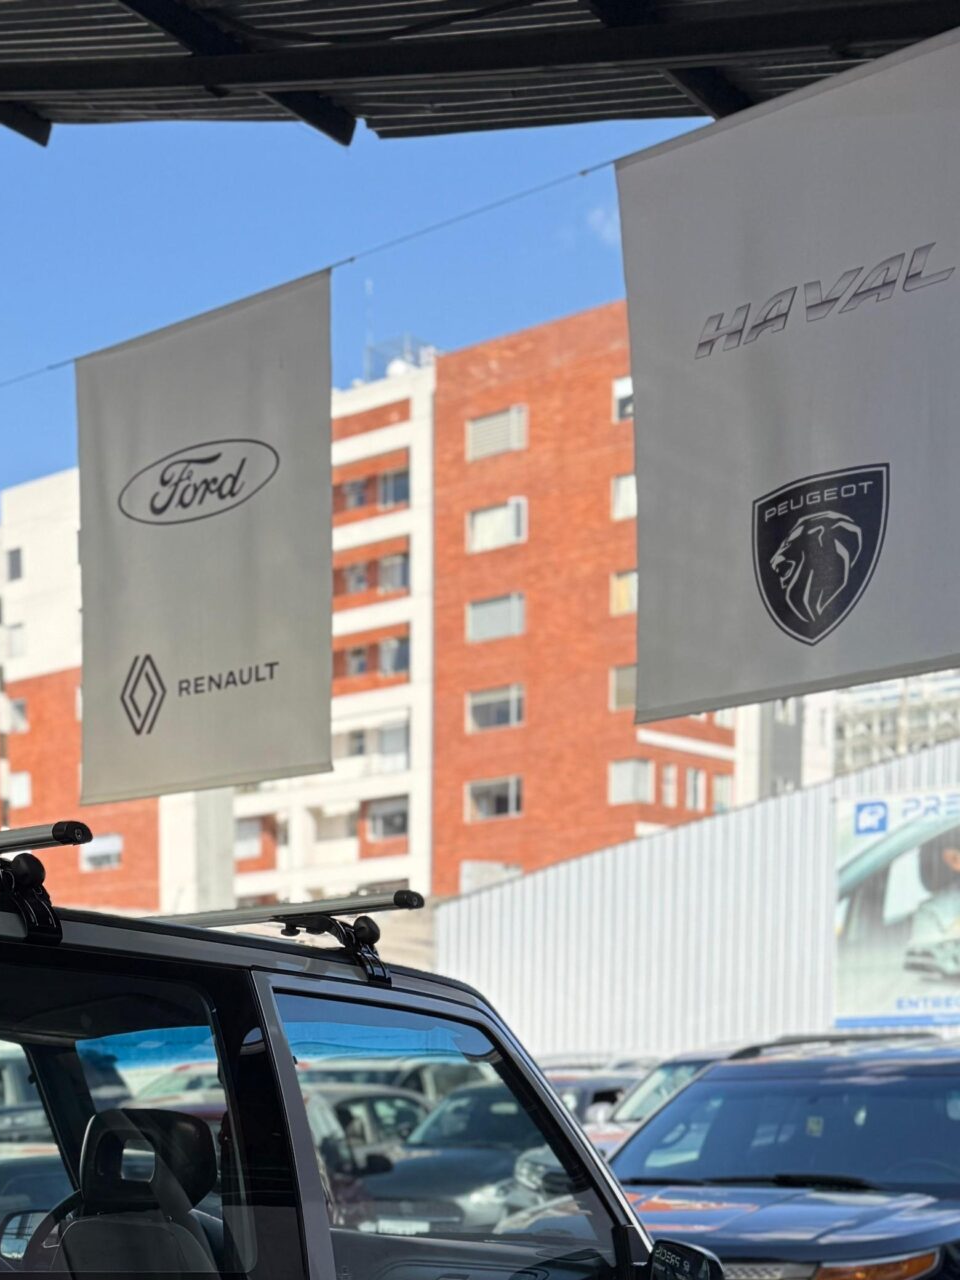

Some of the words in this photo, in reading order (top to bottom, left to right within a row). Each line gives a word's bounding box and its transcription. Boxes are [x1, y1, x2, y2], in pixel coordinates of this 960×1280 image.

[694, 241, 956, 360] HAVAL
[149, 451, 248, 516] Ford
[763, 480, 874, 523] PEUGEOT
[177, 660, 280, 698] RENAULT
